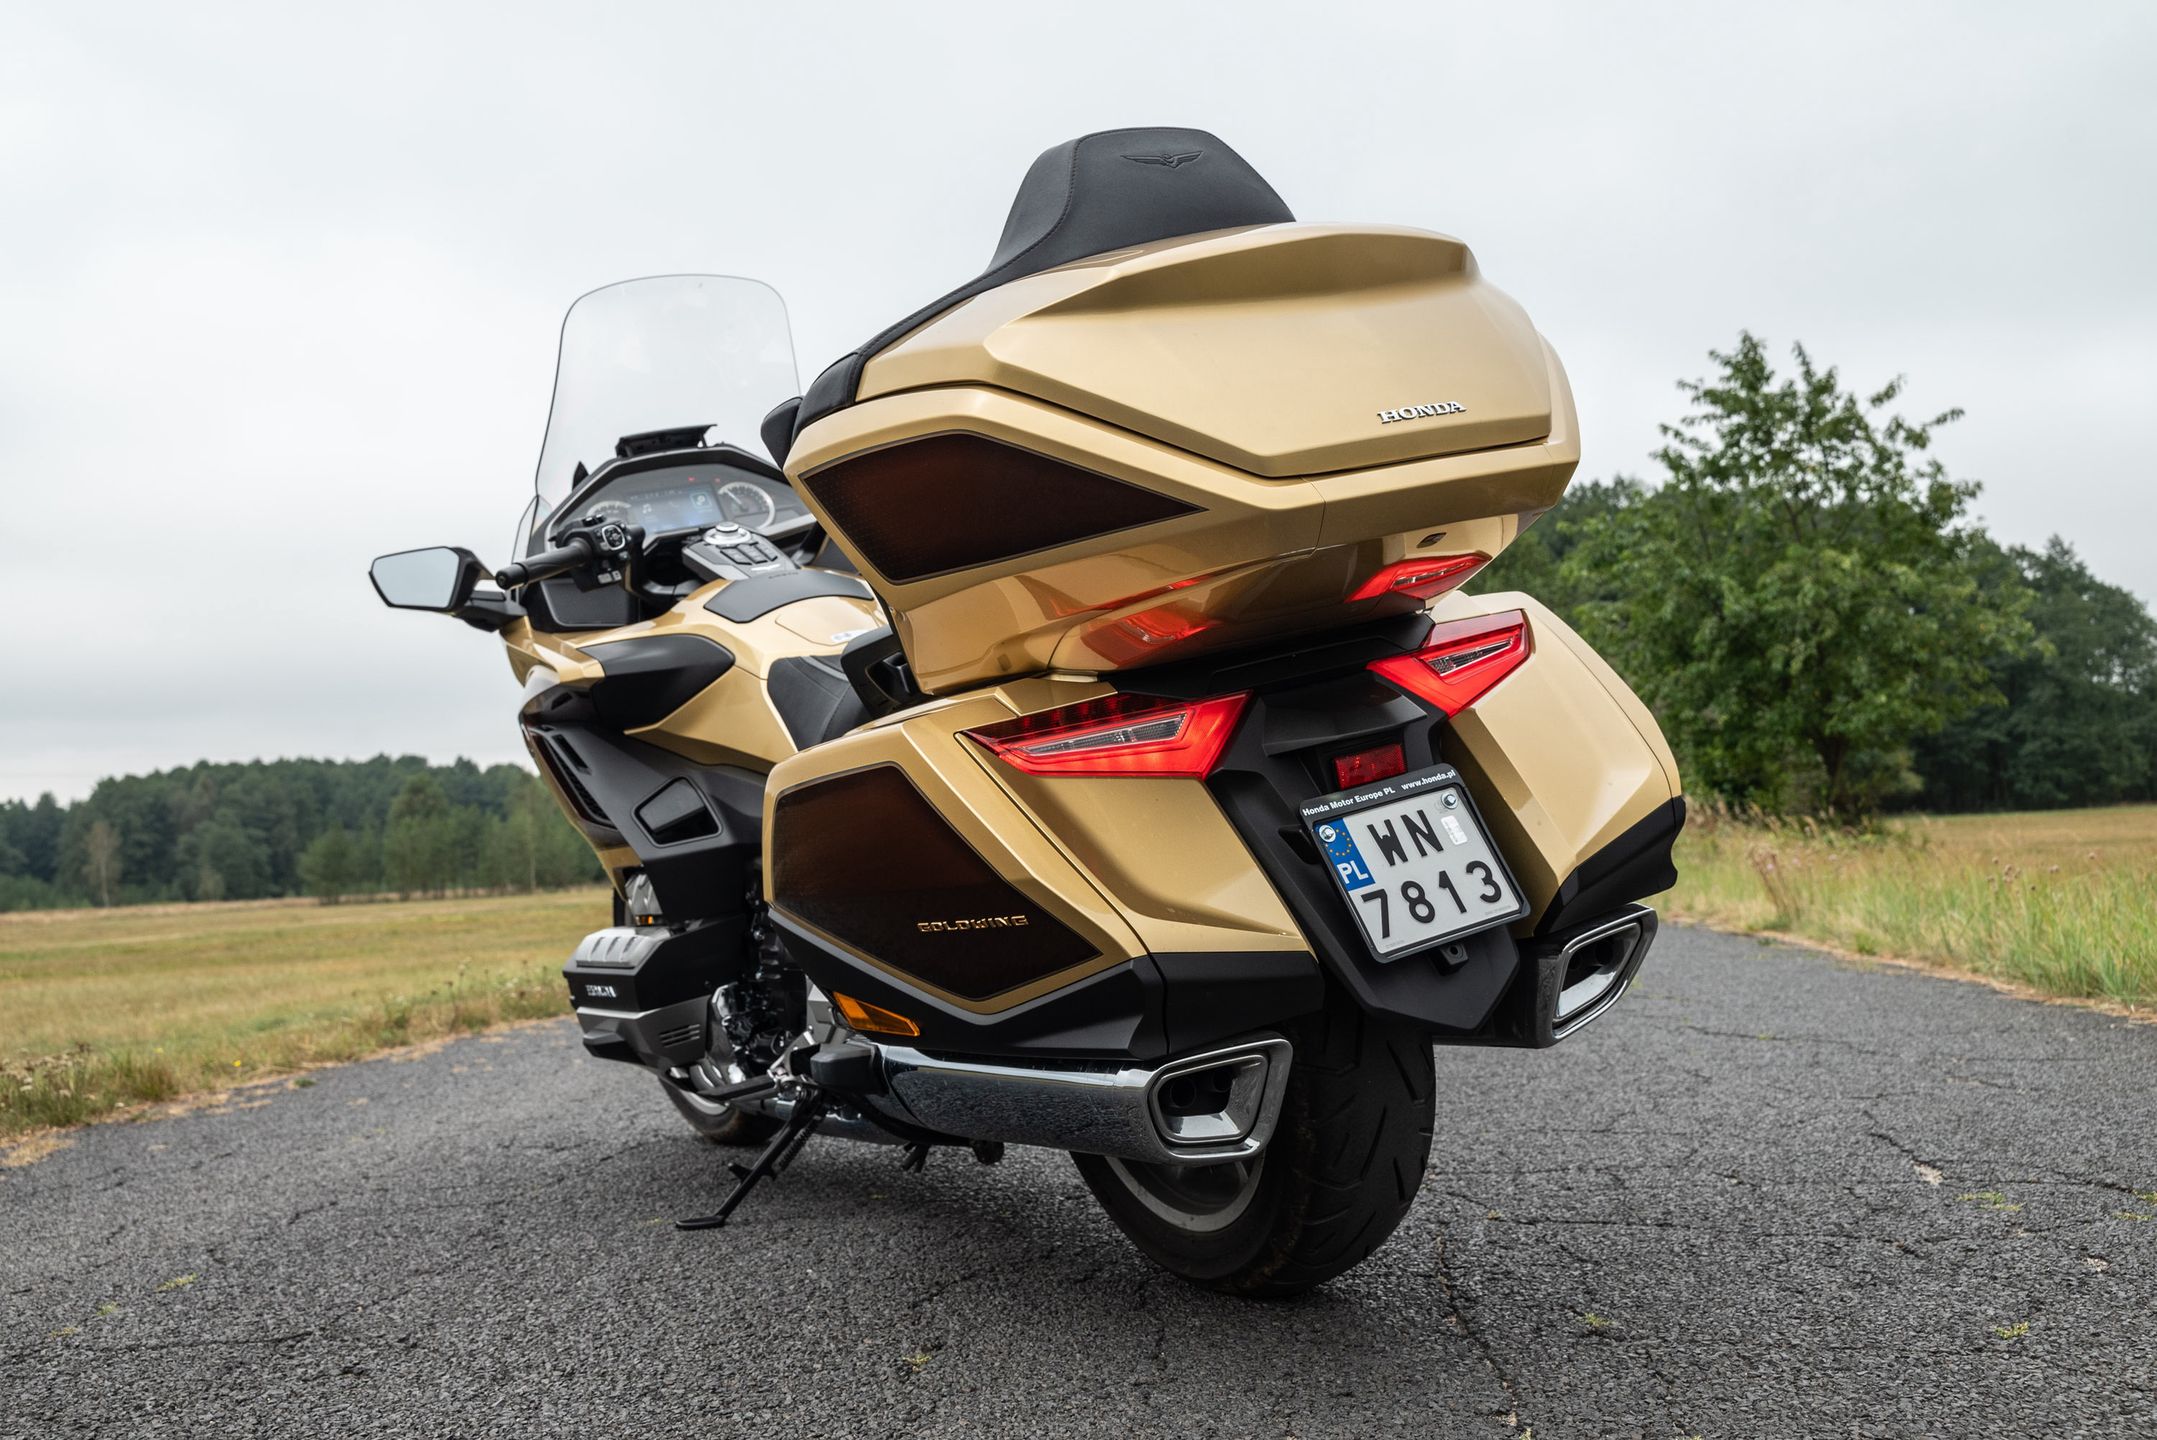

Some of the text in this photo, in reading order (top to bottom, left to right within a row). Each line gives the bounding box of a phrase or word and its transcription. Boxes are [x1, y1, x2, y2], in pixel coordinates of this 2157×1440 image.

[1377, 401, 1466, 424] HONDA
[1302, 769, 1456, 816] Honda Motor Europe PL www.honda.pl
[1367, 809, 1444, 867] WN
[1336, 860, 1369, 884] PL
[1361, 860, 1502, 939] 7813
[916, 915, 1029, 932] GOLDWING
